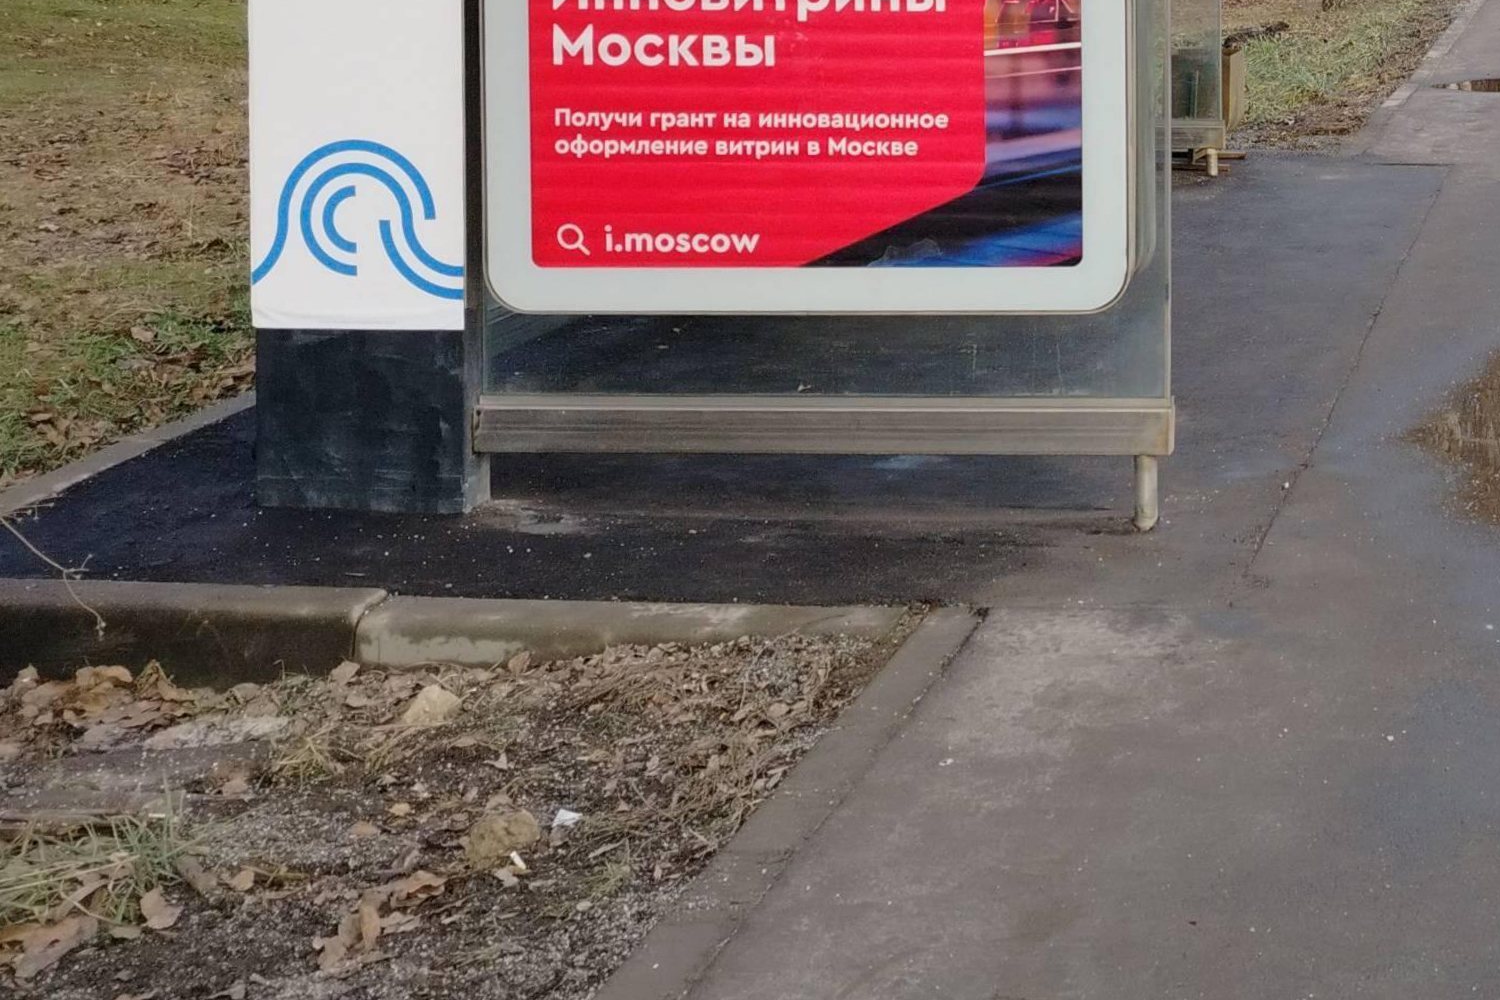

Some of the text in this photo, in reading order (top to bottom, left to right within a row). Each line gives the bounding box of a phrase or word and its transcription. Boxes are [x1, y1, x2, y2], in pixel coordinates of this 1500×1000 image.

[552, 23, 776, 67] Москвы
[554, 108, 949, 131] Получи грант на инновационное
[554, 133, 918, 159] оформление витрин в Москве
[604, 224, 760, 253] i.moscow
